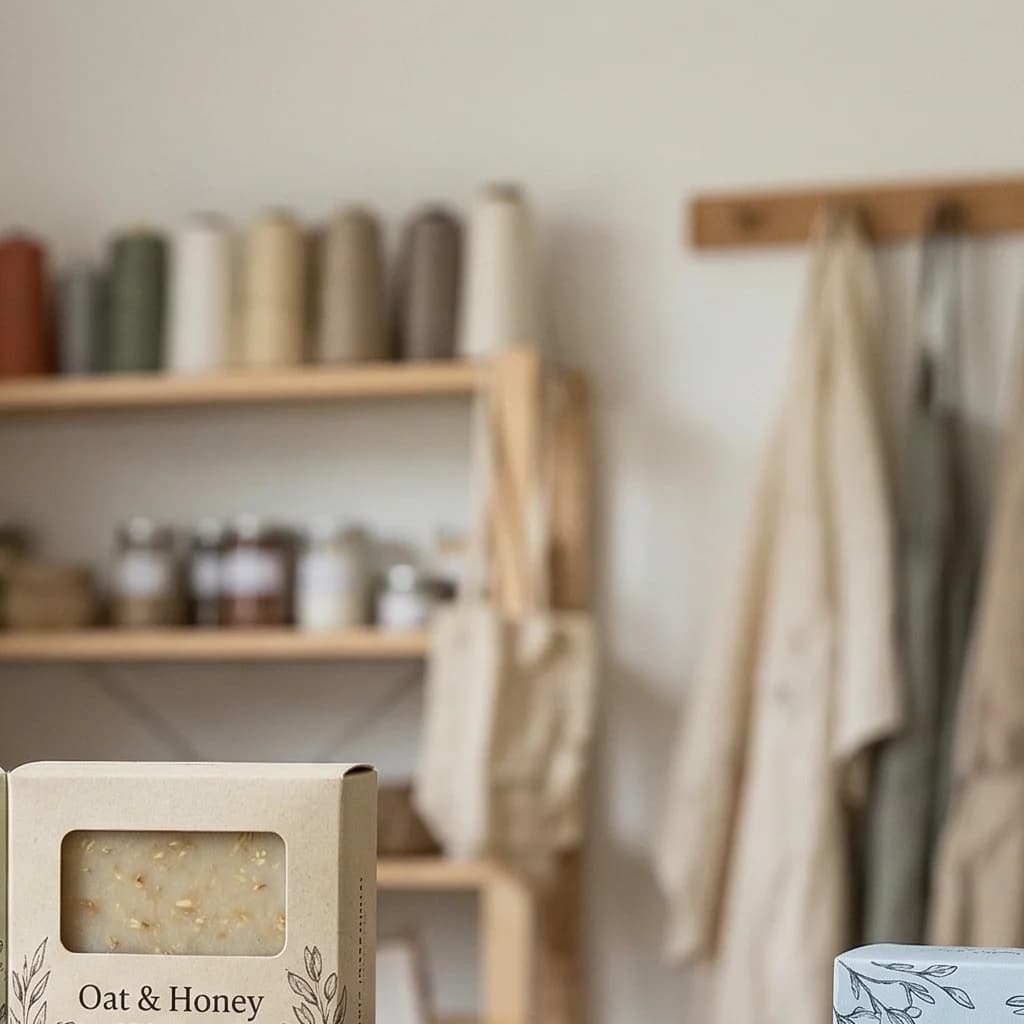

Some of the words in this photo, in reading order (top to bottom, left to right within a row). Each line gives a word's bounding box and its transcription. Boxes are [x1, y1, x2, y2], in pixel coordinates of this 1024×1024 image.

[79, 984, 129, 1010] Oat
[138, 986, 161, 1011] &
[169, 986, 264, 1021] Honey
